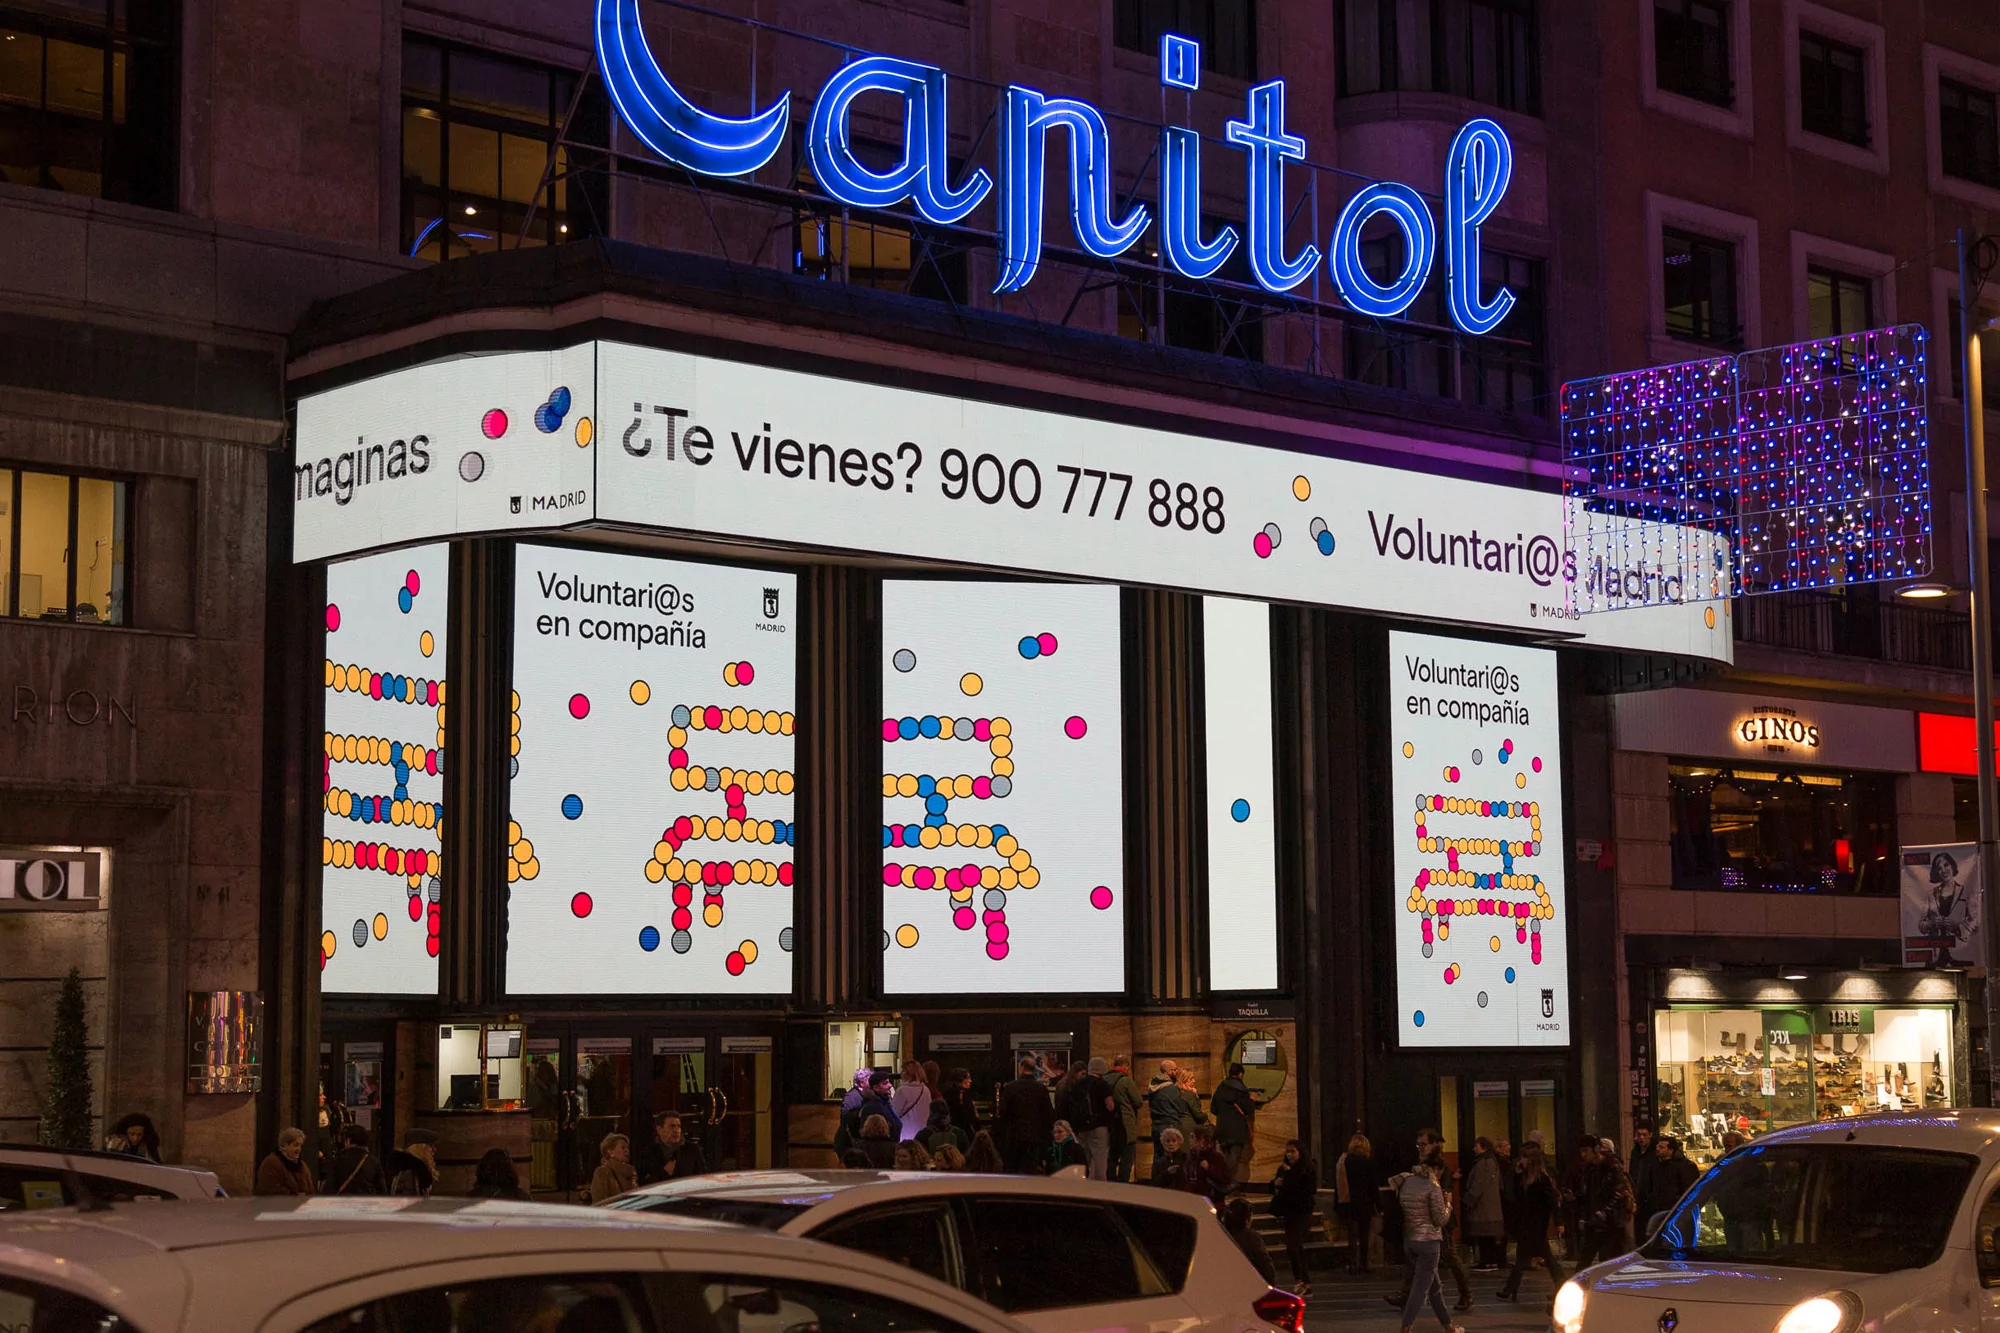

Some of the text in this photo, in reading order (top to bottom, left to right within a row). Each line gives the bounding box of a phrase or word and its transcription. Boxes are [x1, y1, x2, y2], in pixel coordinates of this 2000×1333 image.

[622, 402, 1226, 535] ¿Te vienes? 900 777 888
[532, 490, 586, 510] MADRID
[1368, 510, 1684, 605] Voluntari@s Madrid
[537, 571, 695, 615] Voluntari@s
[755, 622, 786, 633] MADRID
[1542, 606, 1581, 620] MADRID
[536, 614, 706, 650] en compañía
[1405, 655, 1520, 695] Voluntari@s
[13, 684, 137, 728] RION
[1407, 695, 1529, 728] en compañía
[1752, 705, 1797, 717] RISTORANTE
[1740, 717, 1820, 748] GINOS
[1237, 1008, 1269, 1016] TAQUILLA
[1536, 1023, 1560, 1031] MADRID
[1831, 1009, 1860, 1025] IRIS
